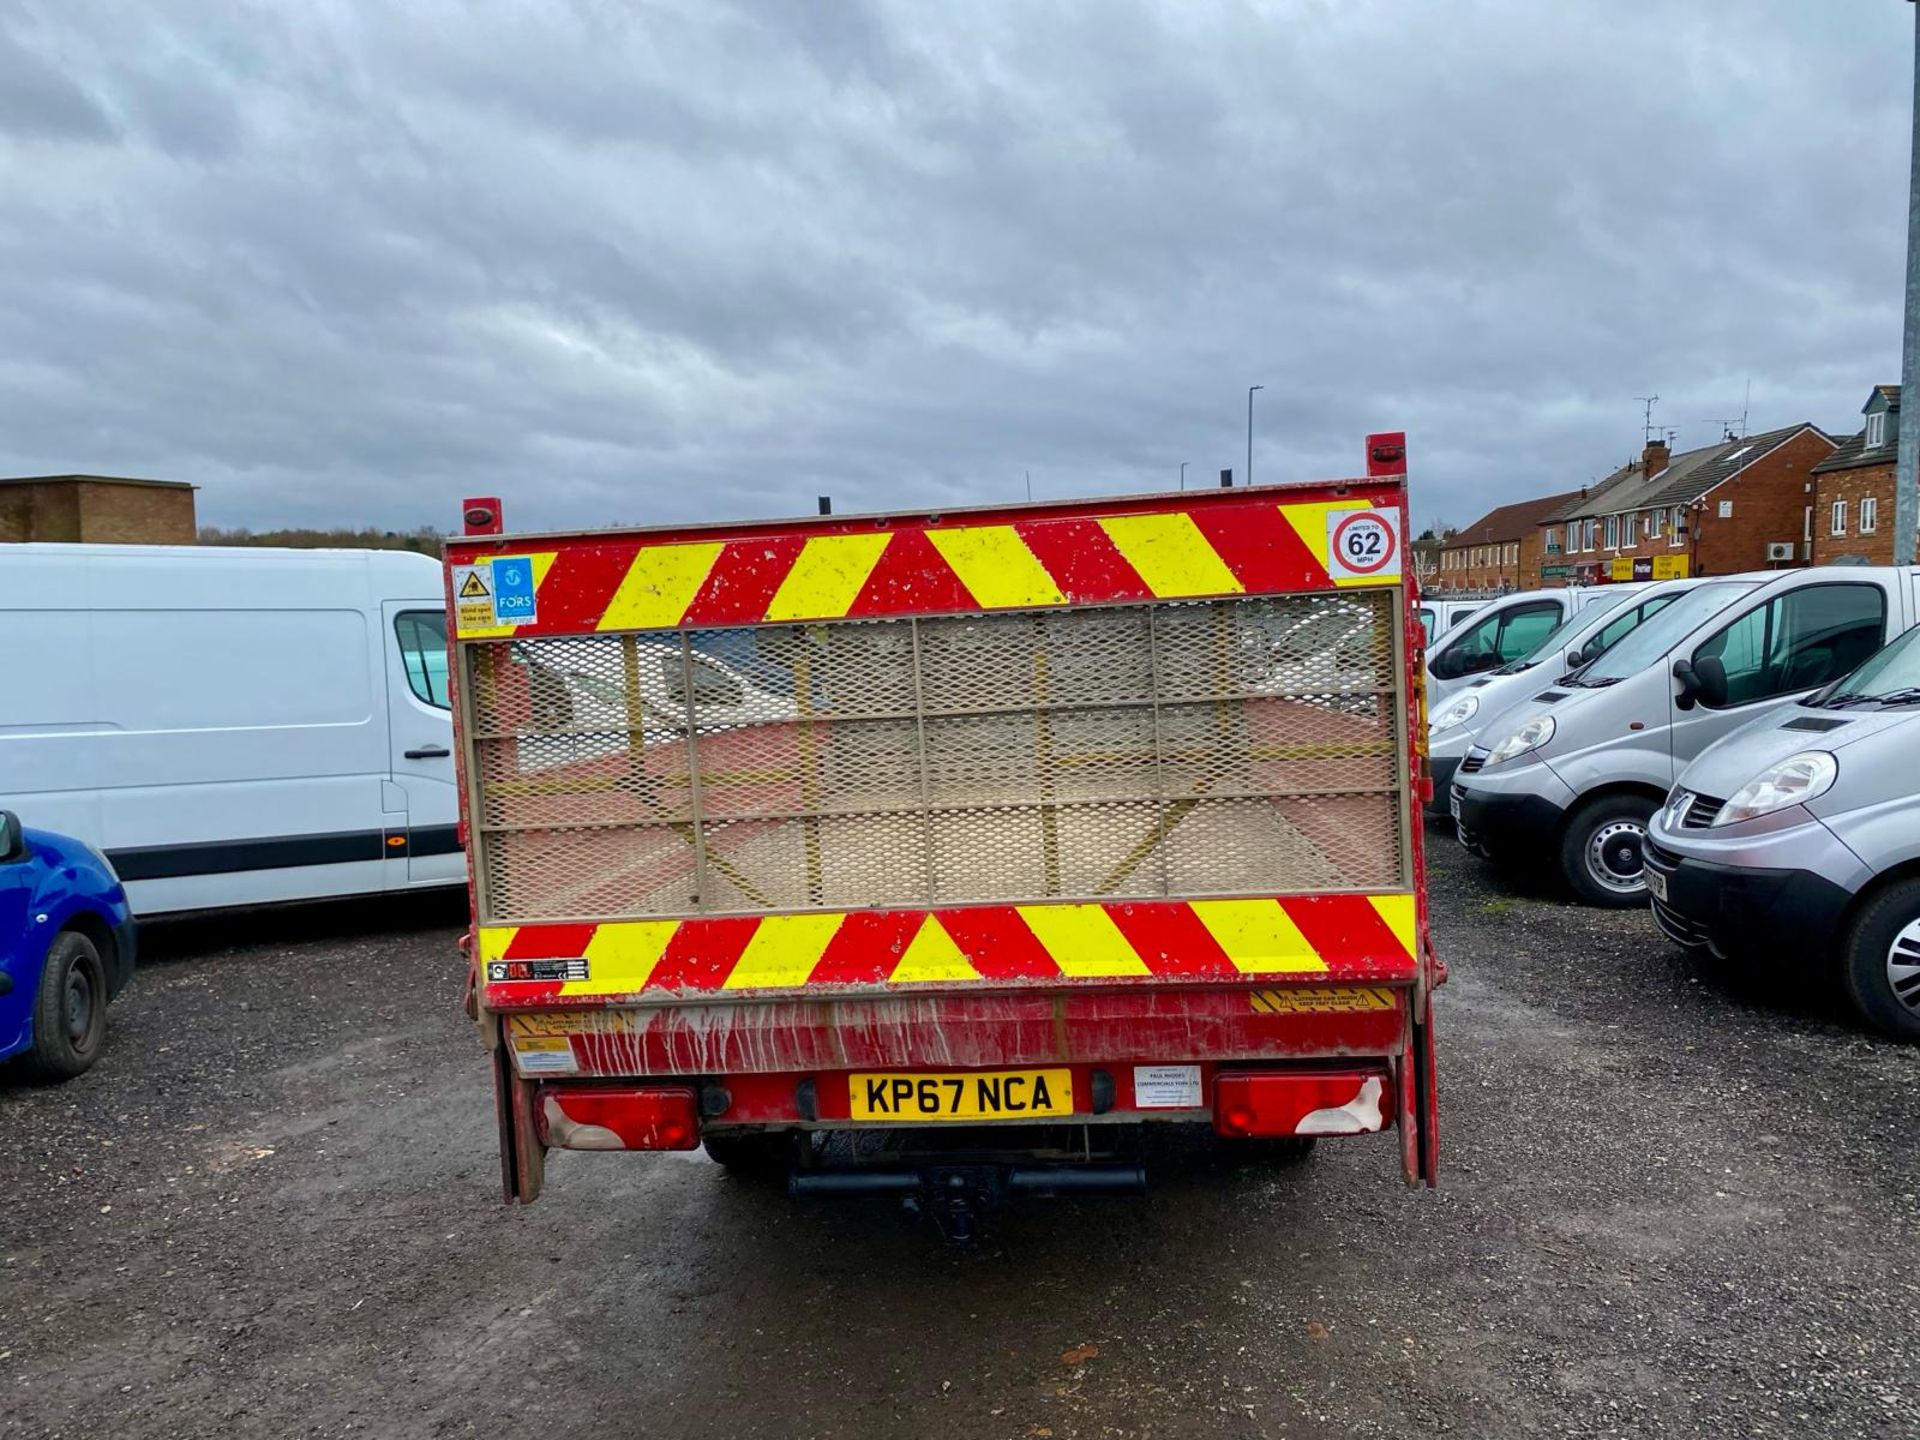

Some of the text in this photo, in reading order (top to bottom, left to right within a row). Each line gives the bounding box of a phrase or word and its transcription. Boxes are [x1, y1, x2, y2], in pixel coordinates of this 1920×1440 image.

[1348, 532, 1381, 556] 62
[499, 596, 532, 608] FORS
[866, 1075, 1053, 1113] KP67 NCA
